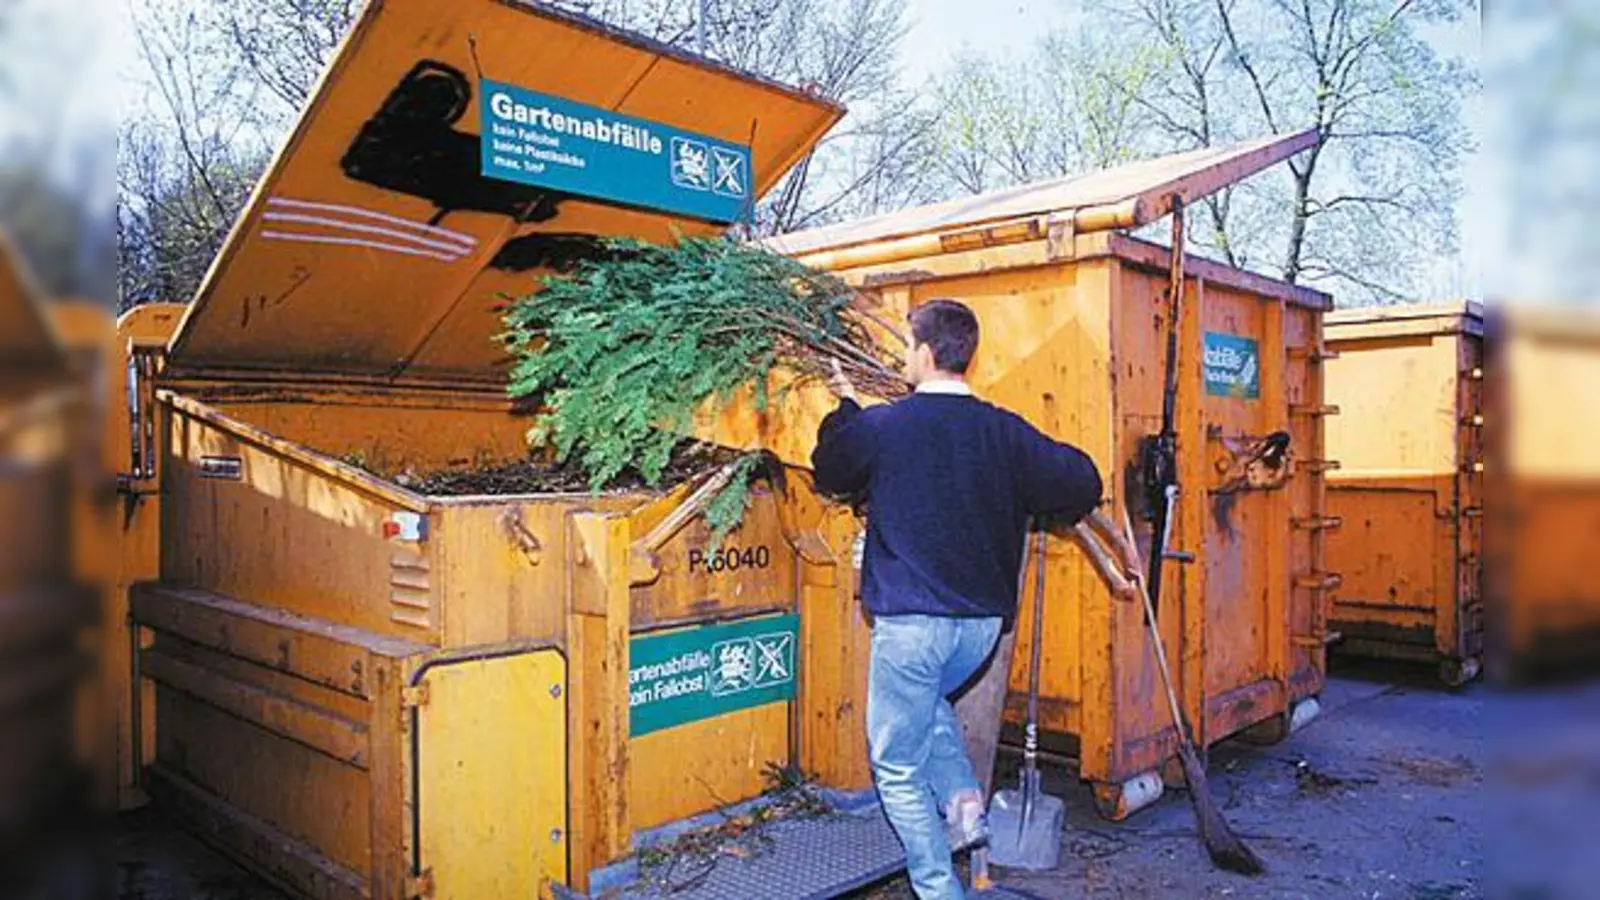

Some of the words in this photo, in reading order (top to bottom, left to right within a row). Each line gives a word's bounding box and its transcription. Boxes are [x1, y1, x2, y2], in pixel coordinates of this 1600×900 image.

[490, 92, 662, 154] Gartenabfälle
[629, 651, 710, 684] artenabfälle
[629, 685, 652, 707] ein
